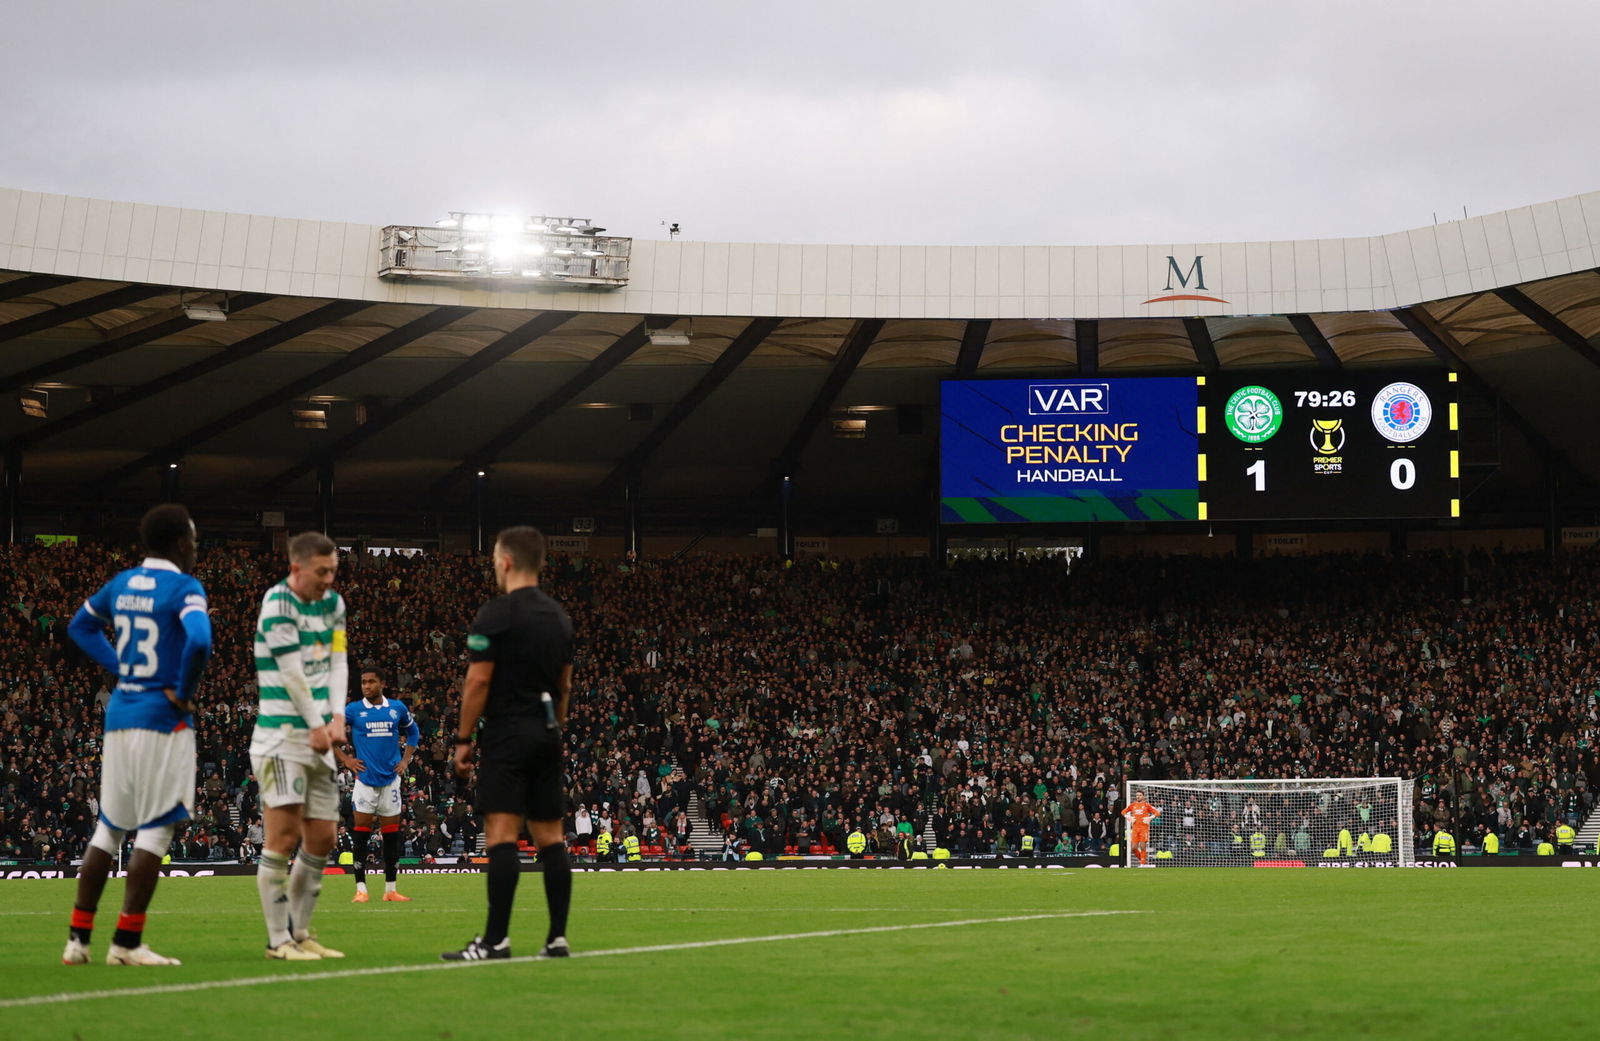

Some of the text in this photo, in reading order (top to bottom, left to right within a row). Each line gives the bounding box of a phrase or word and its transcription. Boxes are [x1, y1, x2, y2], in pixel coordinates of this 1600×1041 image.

[1162, 255, 1209, 291] M
[1034, 388, 1104, 412] VAR
[1294, 390, 1356, 407] 79:26
[1379, 386, 1424, 402] RANGERS
[999, 423, 1139, 443] CHECKING
[1006, 445, 1133, 464] PENALTY
[1313, 456, 1343, 464] PREMIER
[1016, 468, 1123, 483] HANDBALL
[1246, 459, 1266, 492] 1
[1314, 463, 1343, 471] SPORTS
[1390, 457, 1417, 490] 0
[113, 614, 160, 678] 23
[365, 721, 394, 729] UNIBET
